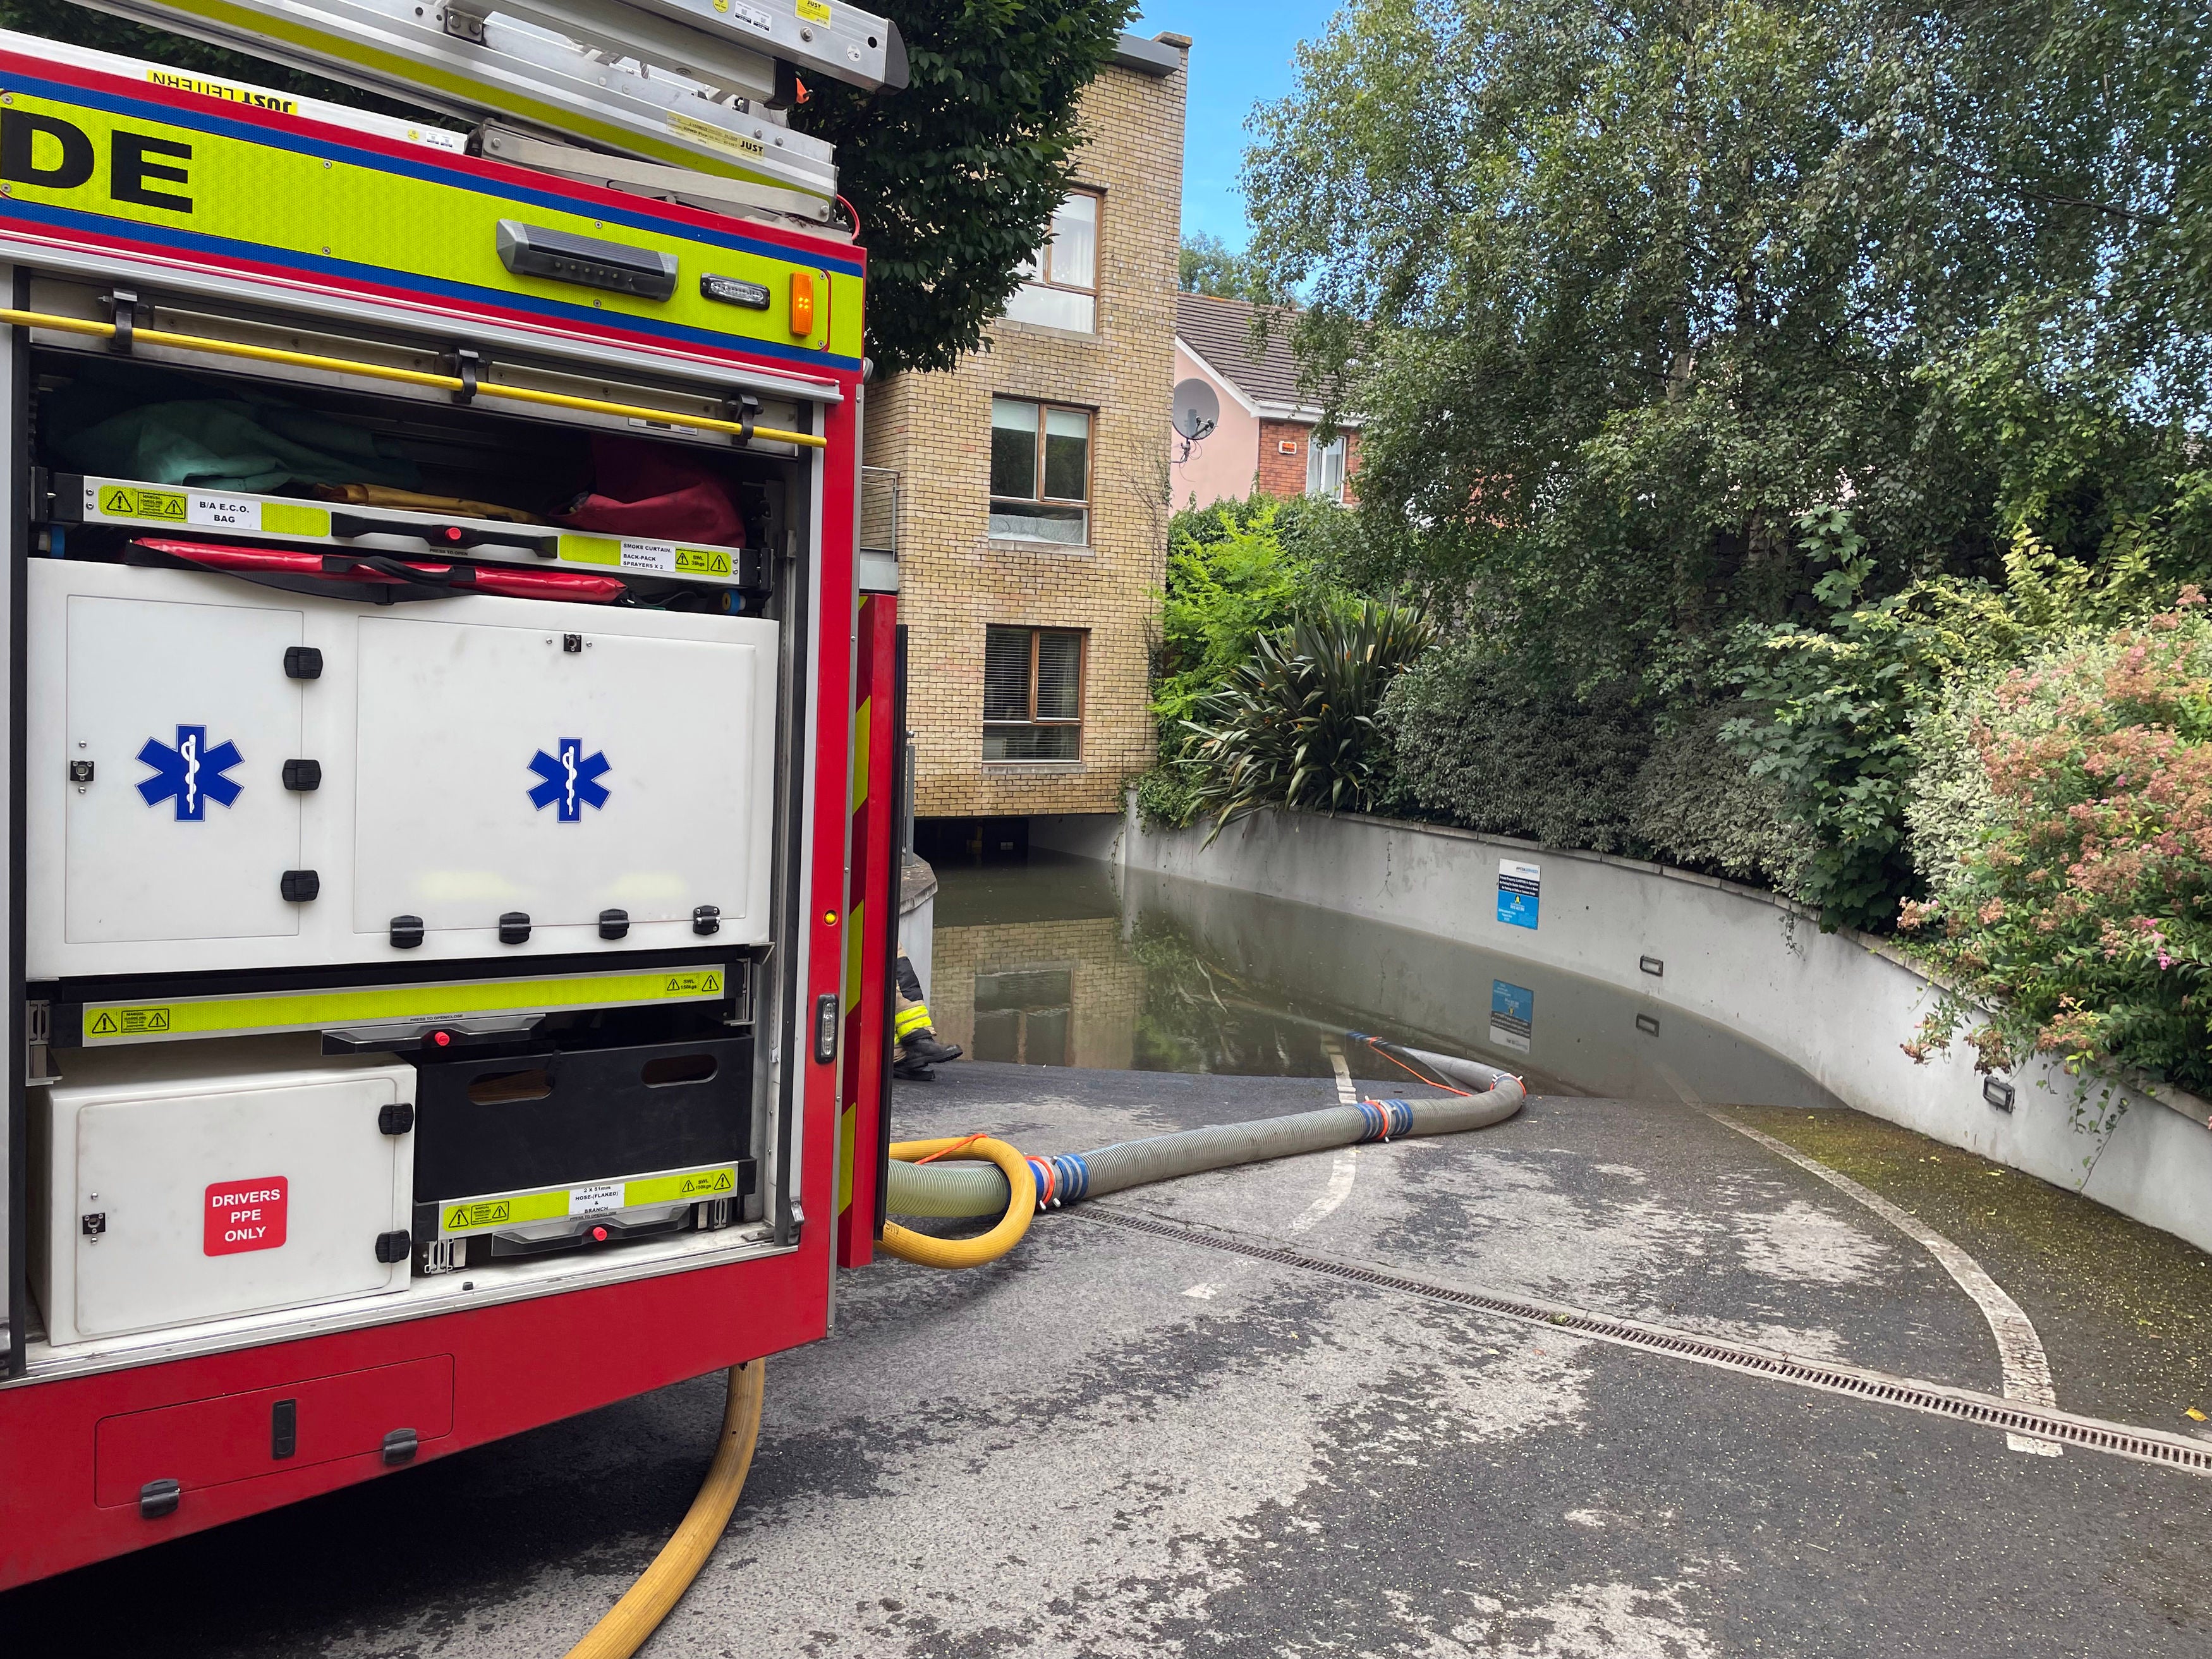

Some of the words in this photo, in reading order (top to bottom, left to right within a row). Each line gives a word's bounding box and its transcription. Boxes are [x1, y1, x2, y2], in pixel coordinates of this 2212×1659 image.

[242, 92, 292, 113] JUST
[740, 140, 763, 152] JUST
[0, 107, 193, 214] DE
[200, 501, 216, 509] B/A
[219, 504, 250, 513] E.C.O.
[212, 1189, 281, 1208] DRIVERS
[231, 1209, 262, 1224] PPE
[225, 1226, 266, 1242] ONLY
